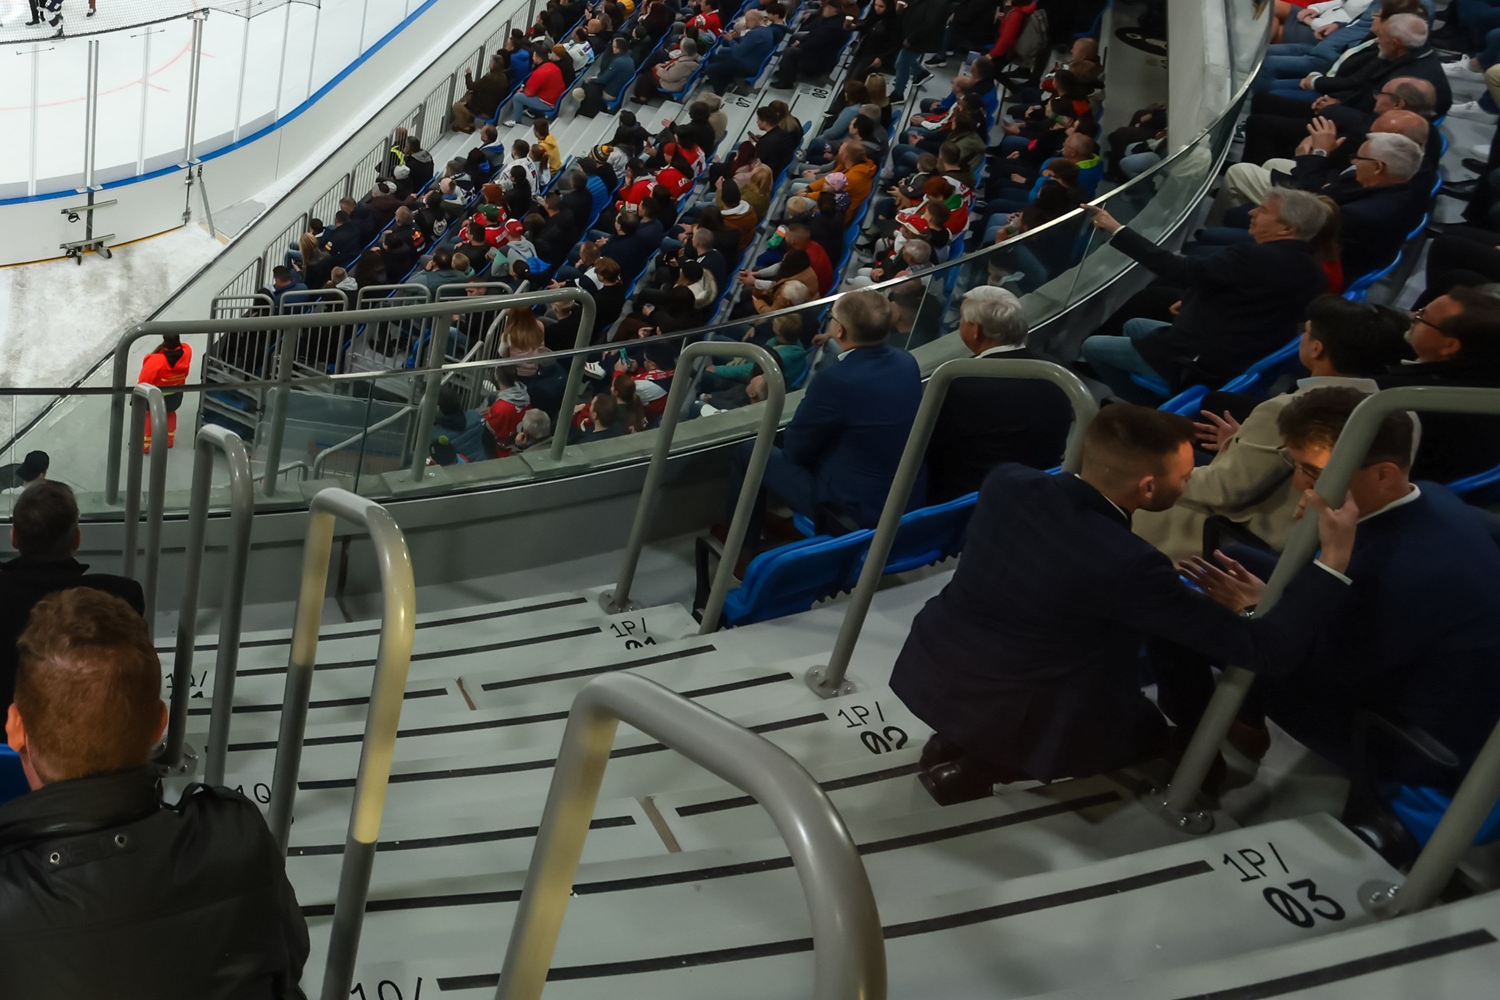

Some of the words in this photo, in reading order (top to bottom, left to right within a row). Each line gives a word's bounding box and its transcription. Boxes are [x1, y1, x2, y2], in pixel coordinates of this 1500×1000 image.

[609, 617, 648, 639] 1P/
[836, 701, 884, 729] 1P/
[1222, 842, 1290, 883] 1P/
[1262, 878, 1346, 928] 03
